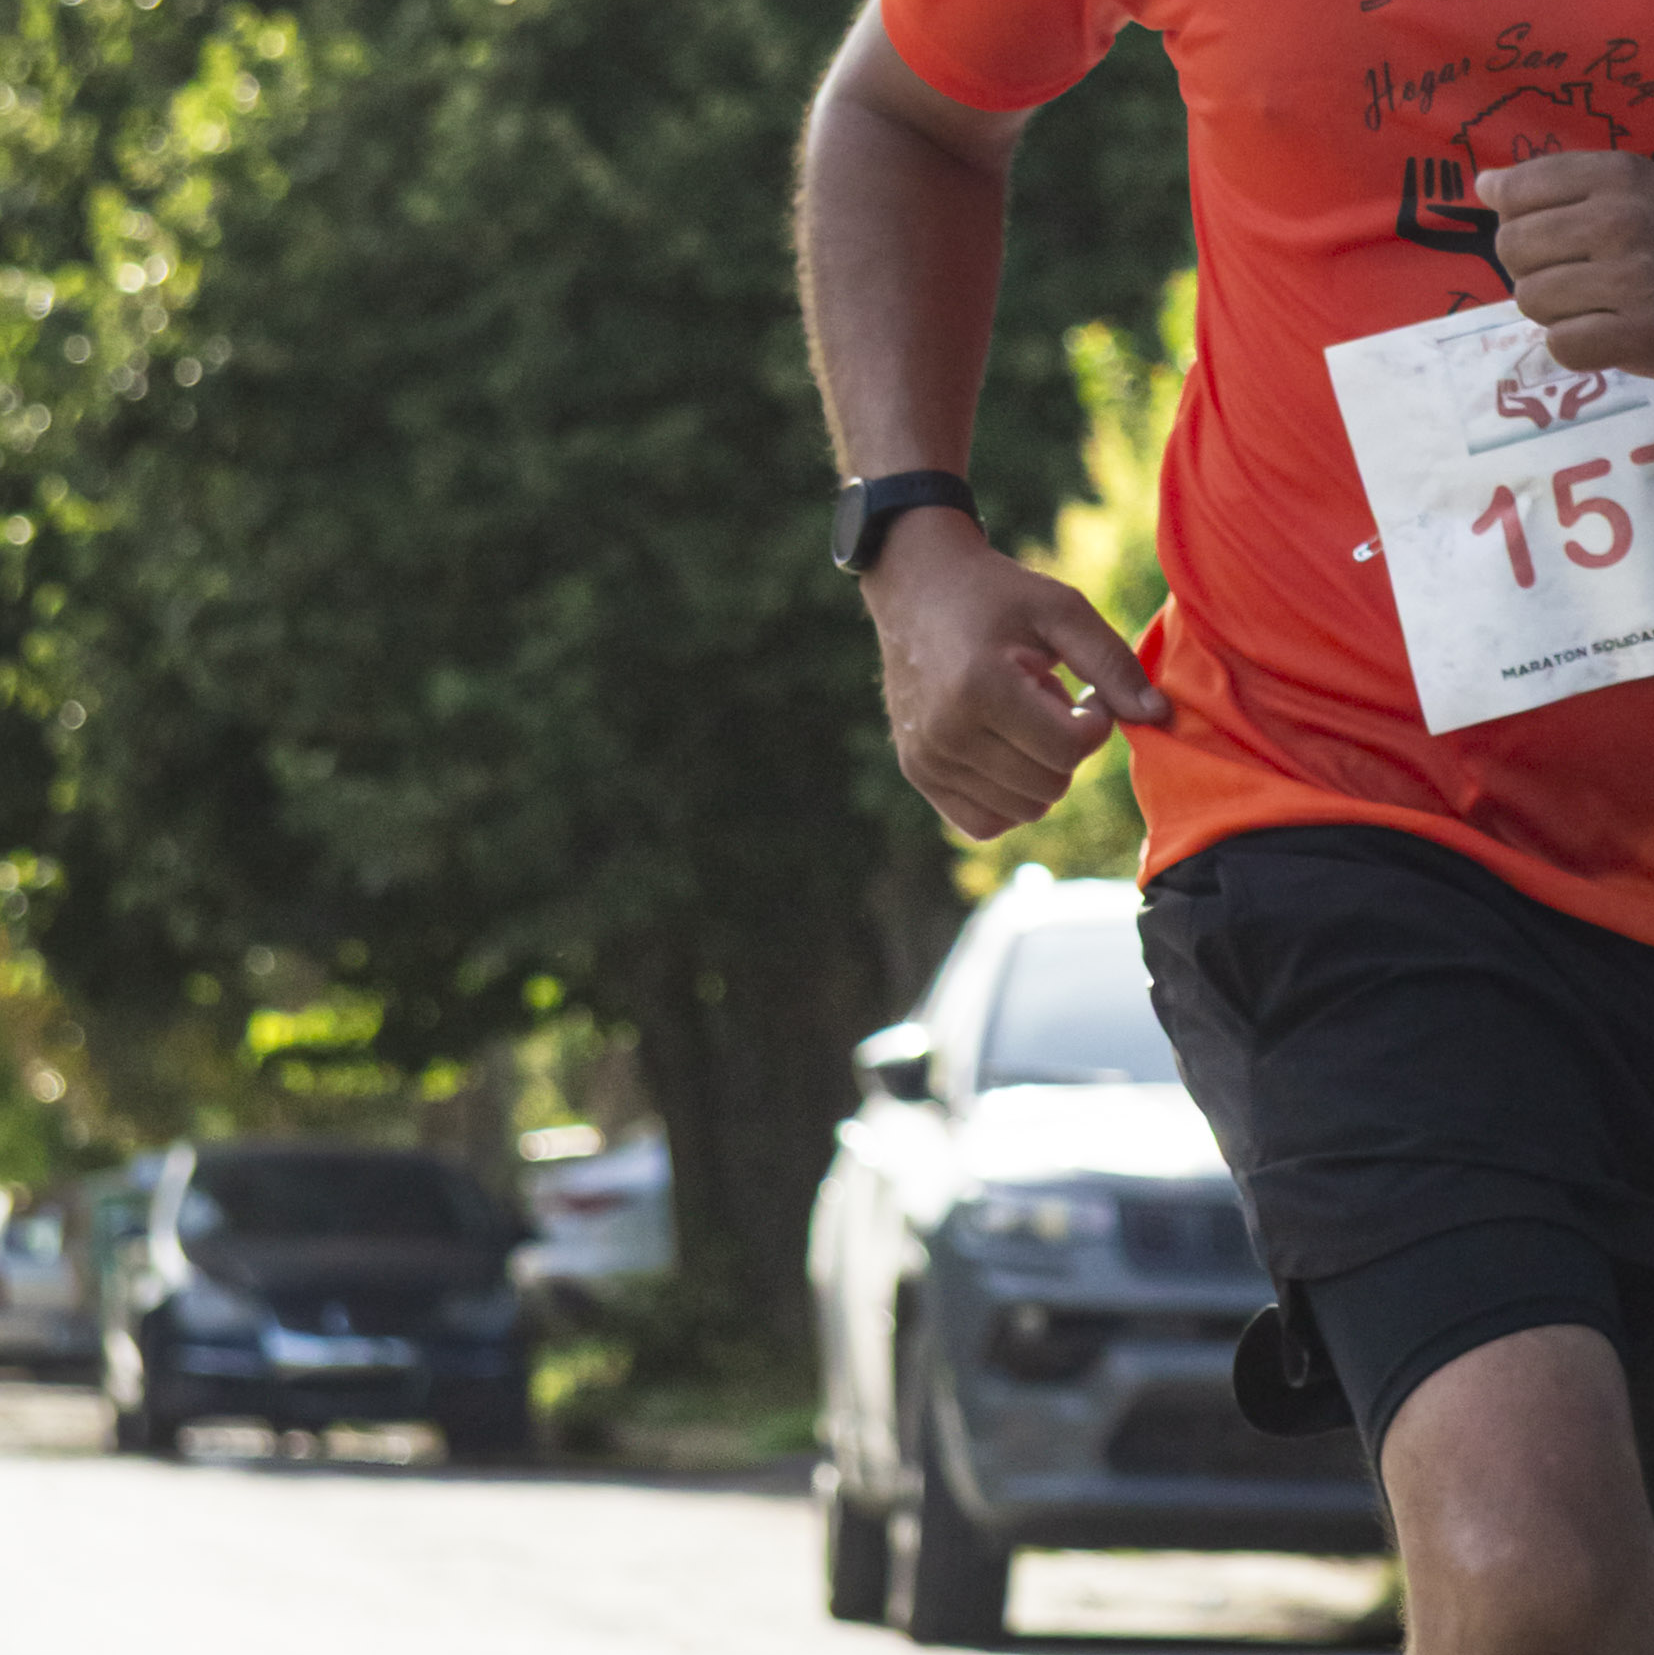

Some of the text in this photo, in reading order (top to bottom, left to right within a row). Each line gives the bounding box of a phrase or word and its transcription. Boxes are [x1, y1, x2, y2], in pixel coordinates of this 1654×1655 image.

[1364, 57, 1471, 132] Hogar
[1485, 22, 1568, 73] San
[1501, 646, 1588, 680] MARATON
